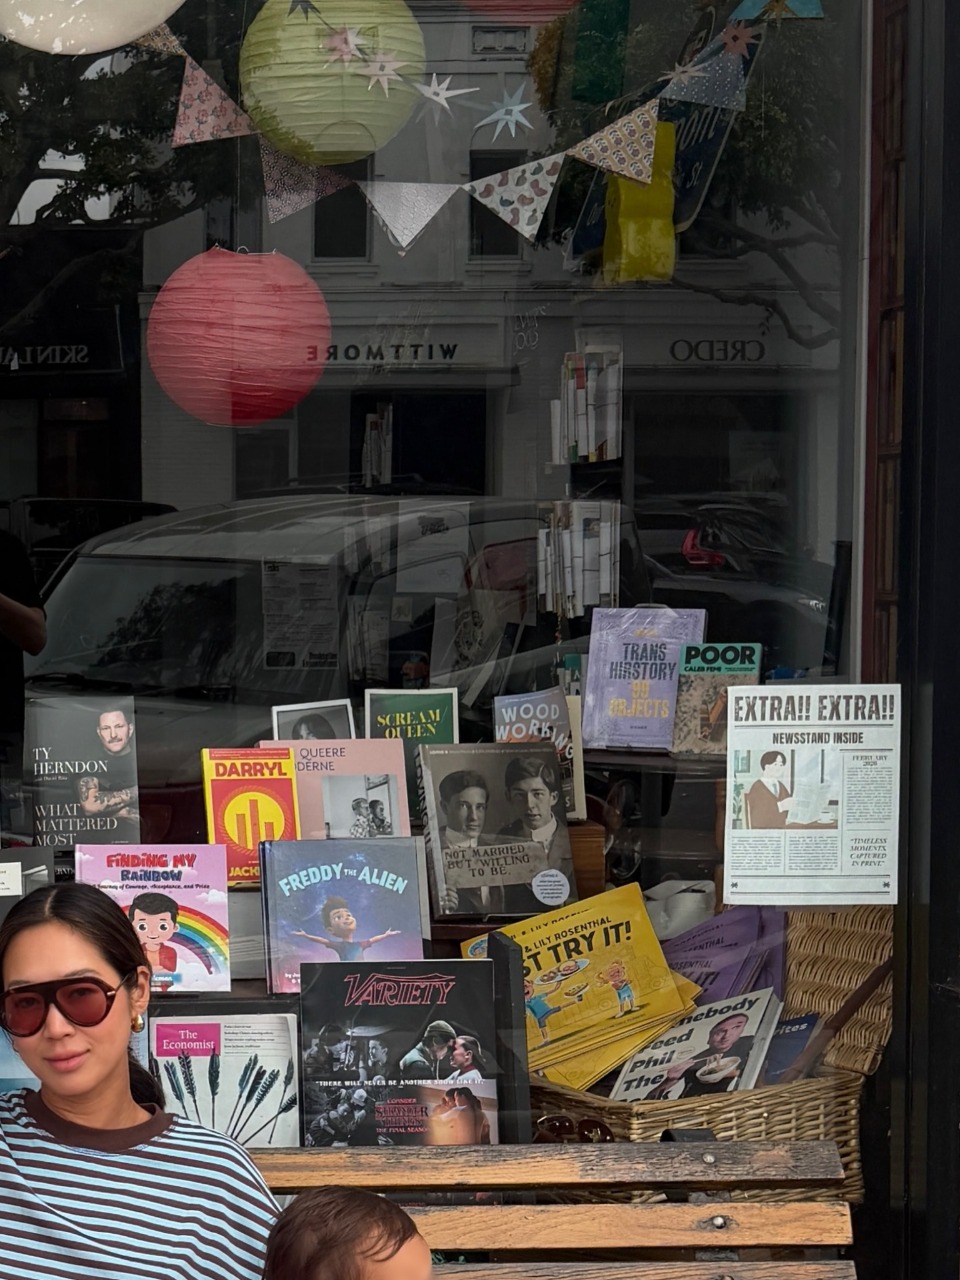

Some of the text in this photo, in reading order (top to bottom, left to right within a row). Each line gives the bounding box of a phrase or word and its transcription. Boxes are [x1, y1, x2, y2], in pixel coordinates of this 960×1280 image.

[622, 643, 667, 662] TRANS
[685, 646, 756, 665] POOR
[501, 703, 560, 723] WOOD
[734, 694, 895, 722] EXTRA!! EXTRA!!
[377, 709, 440, 728] SCREAM
[384, 724, 438, 739] QUEEN
[495, 719, 574, 759] WORKING
[772, 732, 864, 745] NEWSSTAND INSIDE
[33, 747, 52, 761] TY
[300, 747, 346, 760] QUEERE
[34, 760, 108, 775] HERNDON
[215, 762, 287, 777] DARRYL
[35, 804, 80, 817] WHAT
[36, 817, 118, 832] MATTERED
[36, 833, 76, 847] MOST
[445, 845, 525, 860] NOT MARRIED
[172, 853, 197, 868] MY
[447, 854, 530, 870] BUT WILLING
[469, 866, 512, 877] TO BE.
[278, 862, 408, 897] FREDDY THE ALIEN
[524, 945, 532, 953] &
[533, 935, 552, 949] LILY
[554, 916, 612, 940] ROSENTHAL
[547, 931, 595, 963] TRY
[603, 920, 632, 947] IT!
[344, 973, 456, 1006] VARIETY
[179, 1030, 198, 1040] The
[163, 1040, 215, 1050] Economist
[629, 1050, 675, 1074] Phil
[623, 1072, 665, 1092] The
